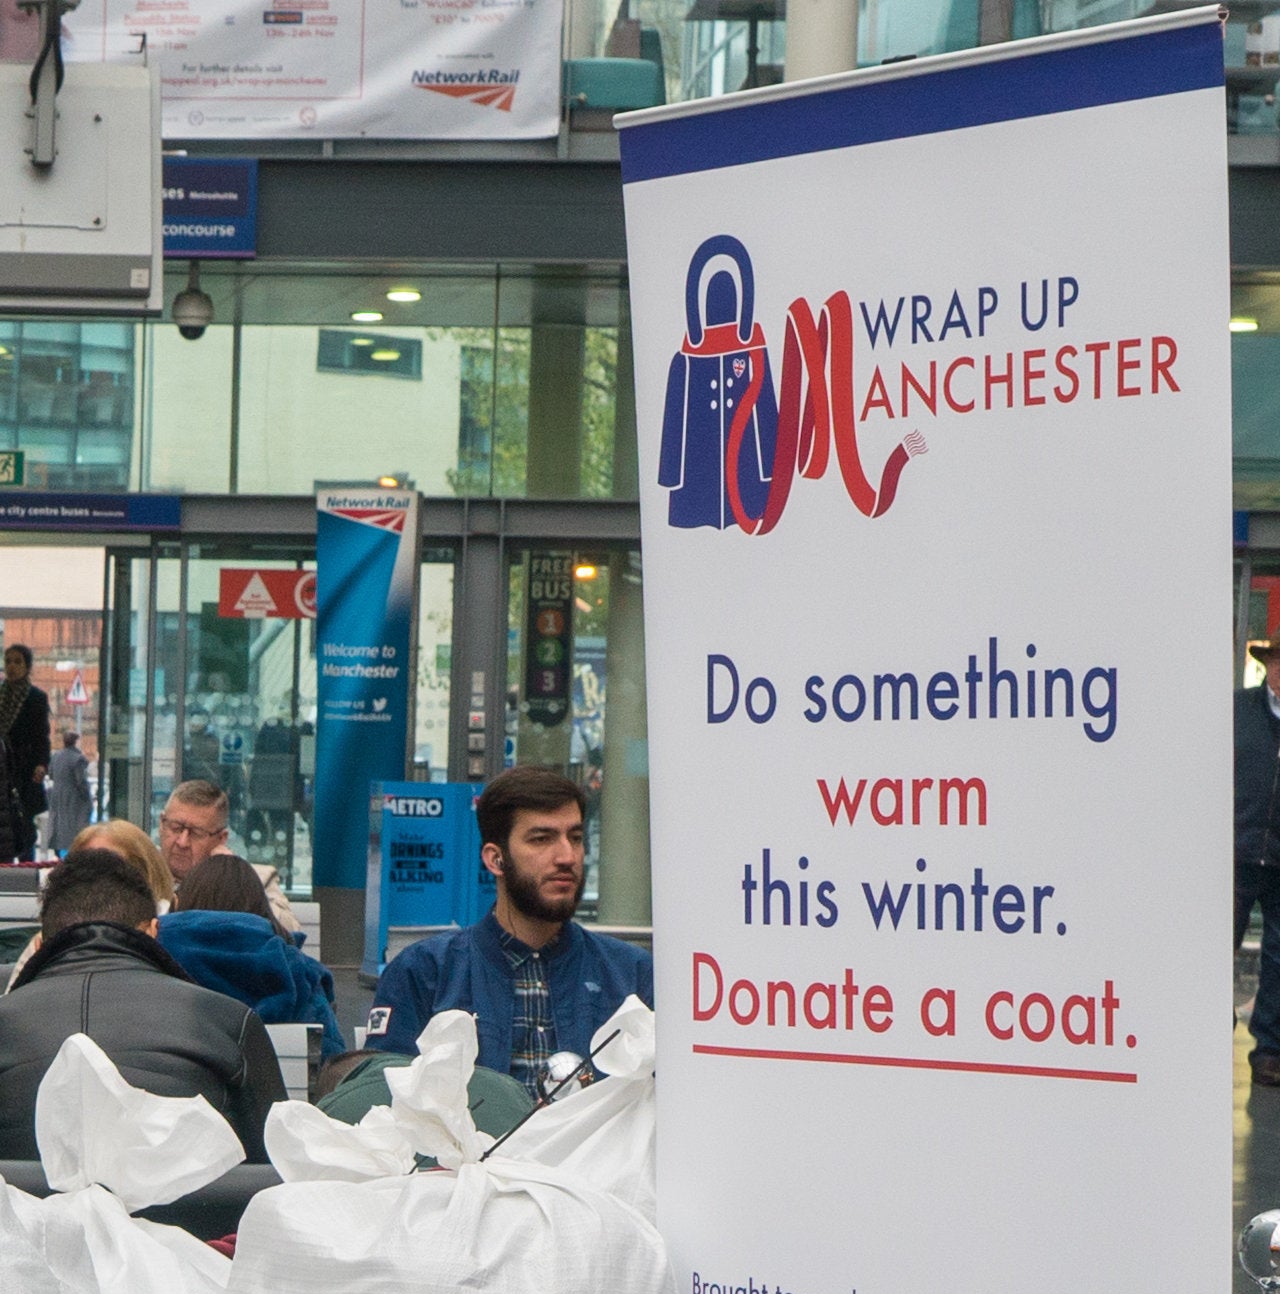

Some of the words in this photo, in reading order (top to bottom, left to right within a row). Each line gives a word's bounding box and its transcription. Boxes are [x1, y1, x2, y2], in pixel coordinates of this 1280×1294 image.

[411, 69, 520, 84] NetworkRail
[859, 287, 998, 350] WRAP
[1021, 277, 1079, 331] UP
[327, 497, 410, 509] NetworkRail
[322, 663, 399, 678] Manchester
[323, 643, 379, 658] Welcome
[381, 645, 396, 658] to
[707, 654, 777, 724] Do
[804, 637, 1117, 743] something
[817, 776, 987, 827] warm
[742, 848, 838, 928] this
[861, 858, 1066, 936] winter.
[693, 952, 893, 1033] Donate
[921, 988, 955, 1036] a
[985, 980, 1137, 1048] coat.
